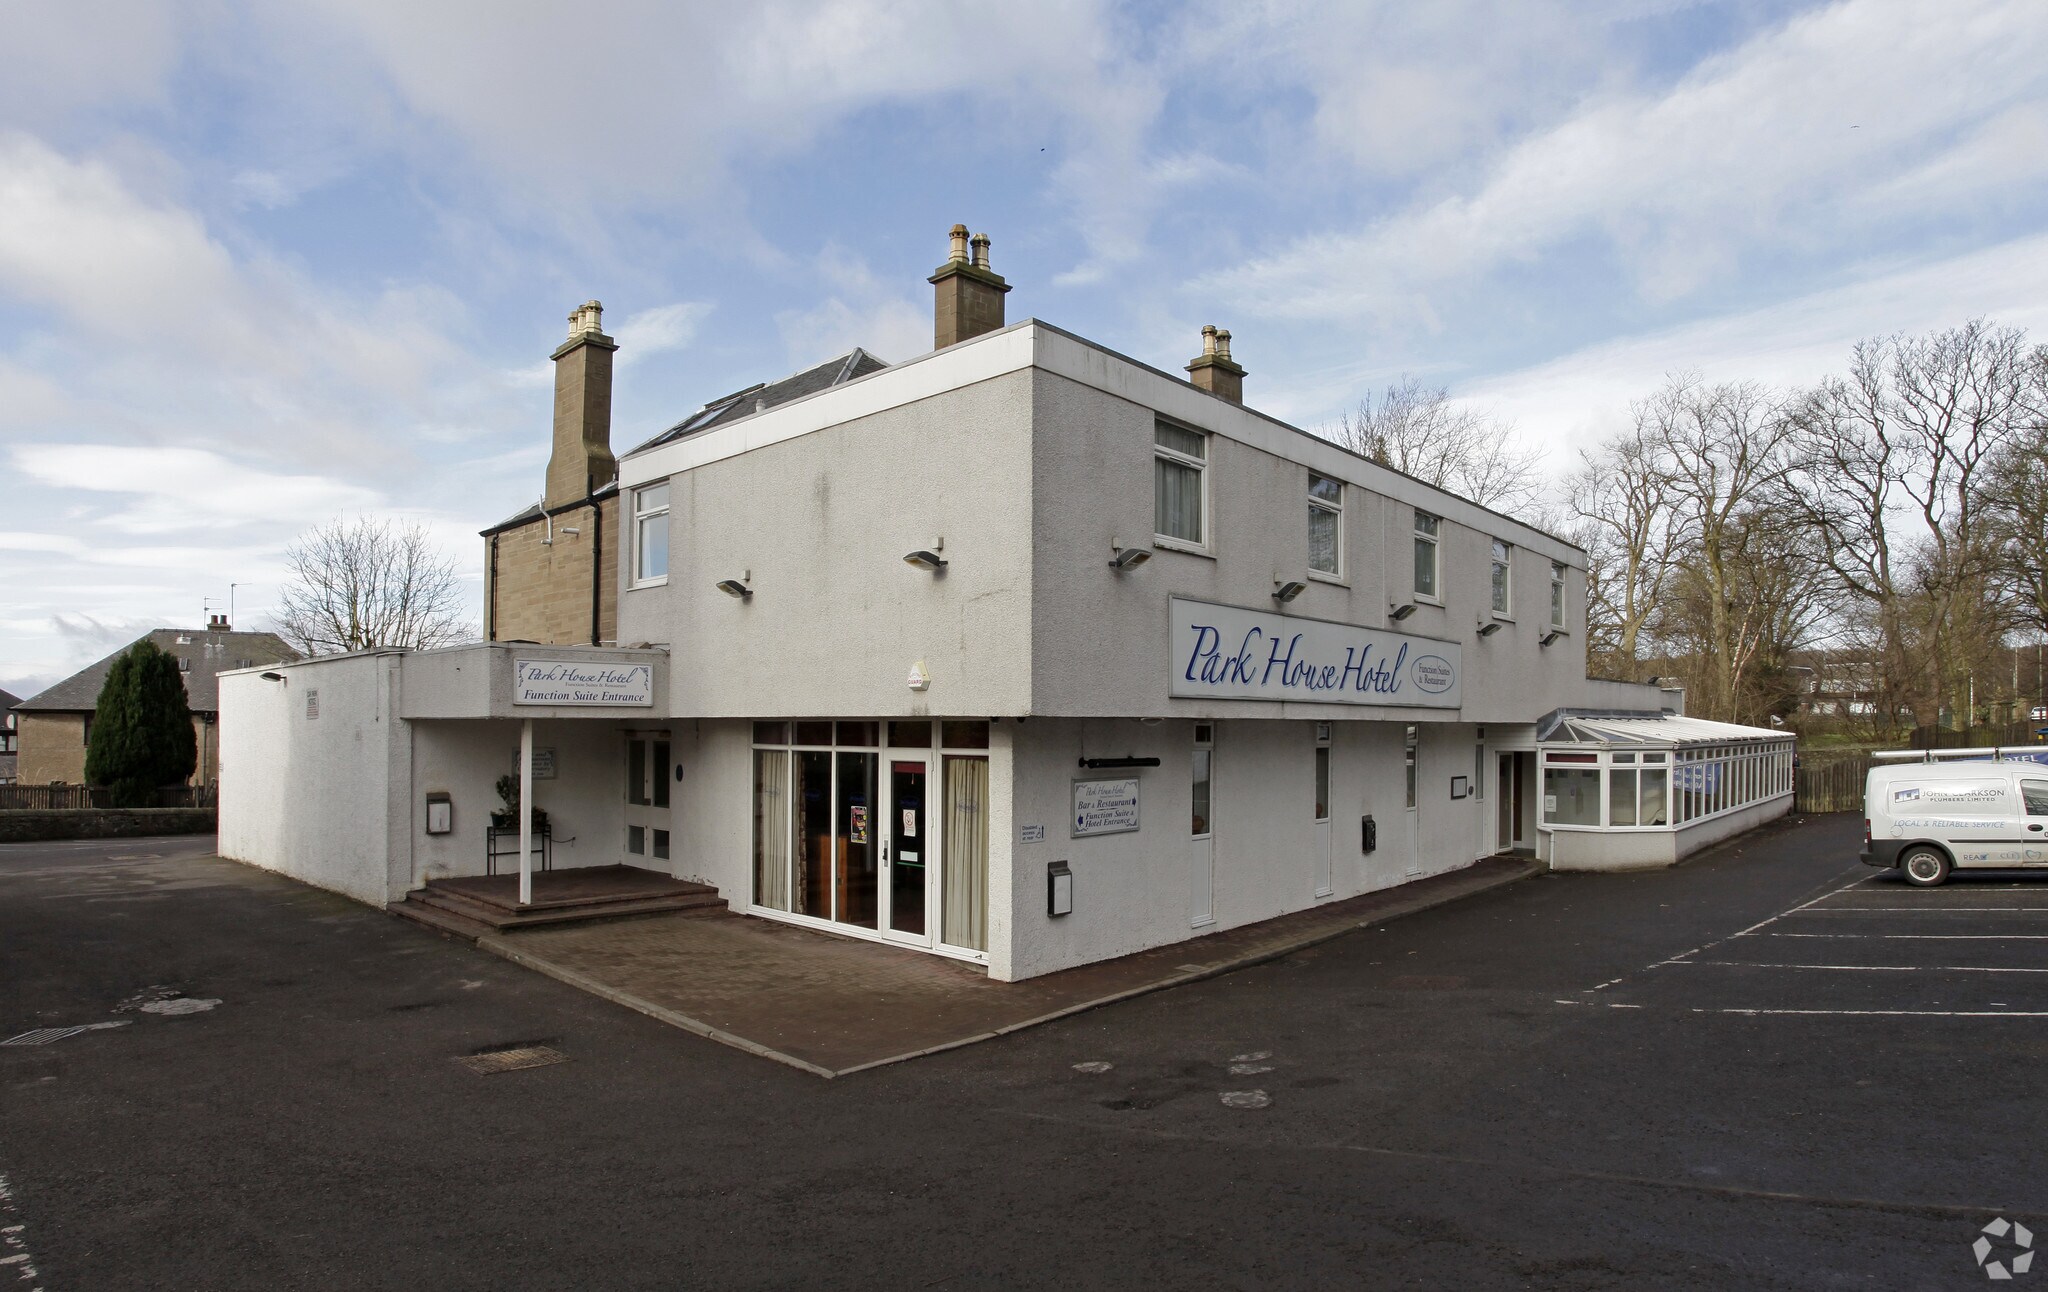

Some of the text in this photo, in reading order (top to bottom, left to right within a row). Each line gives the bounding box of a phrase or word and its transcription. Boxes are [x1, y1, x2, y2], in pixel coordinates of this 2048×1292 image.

[1185, 624, 1408, 693] Park House Hotel
[527, 664, 638, 684] Park House Hotel
[1419, 662, 1437, 674] Function
[524, 689, 645, 702] Function Suite Entrance
[1078, 800, 1090, 810] Bar
[1097, 798, 1131, 808] Restaurant
[1085, 811, 1113, 820] Function
[1114, 809, 1129, 818] Suite
[1085, 817, 1130, 828] Hotel Entrance
[1894, 819, 1921, 828] LOCAL
[1932, 820, 1969, 828] RELIABLE
[1972, 821, 2005, 829] SERVICE
